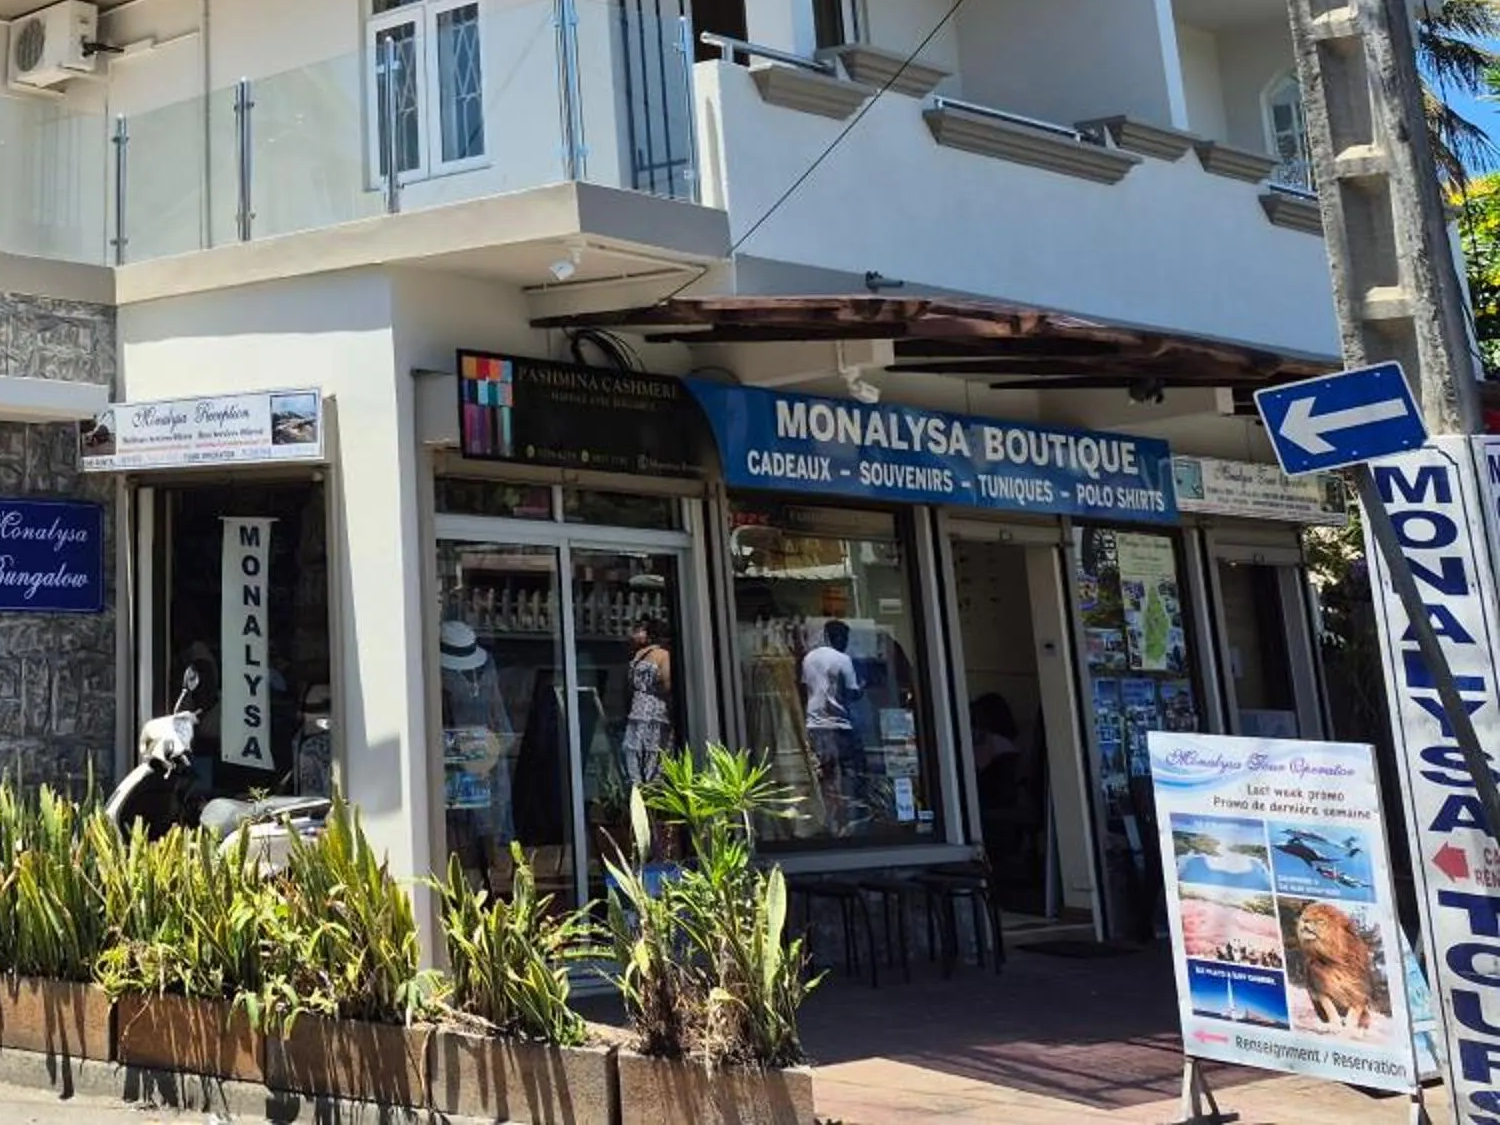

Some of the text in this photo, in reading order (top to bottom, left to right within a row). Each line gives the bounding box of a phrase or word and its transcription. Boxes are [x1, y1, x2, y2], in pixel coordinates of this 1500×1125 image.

[775, 400, 1139, 478] MONALYSA BOUTIQUE
[747, 449, 832, 482] CADEAUX
[859, 460, 954, 493] SOUVENIRS
[978, 474, 1053, 505] TUNIQUES
[1076, 483, 1113, 507] POLO
[1117, 488, 1165, 512] SHIRTS
[239, 525, 263, 760] MONALYSA
[1213, 795, 1249, 810] Promo
[1251, 799, 1265, 812] de
[1322, 807, 1371, 820] semaine
[1247, 784, 1345, 803] Last week promo
